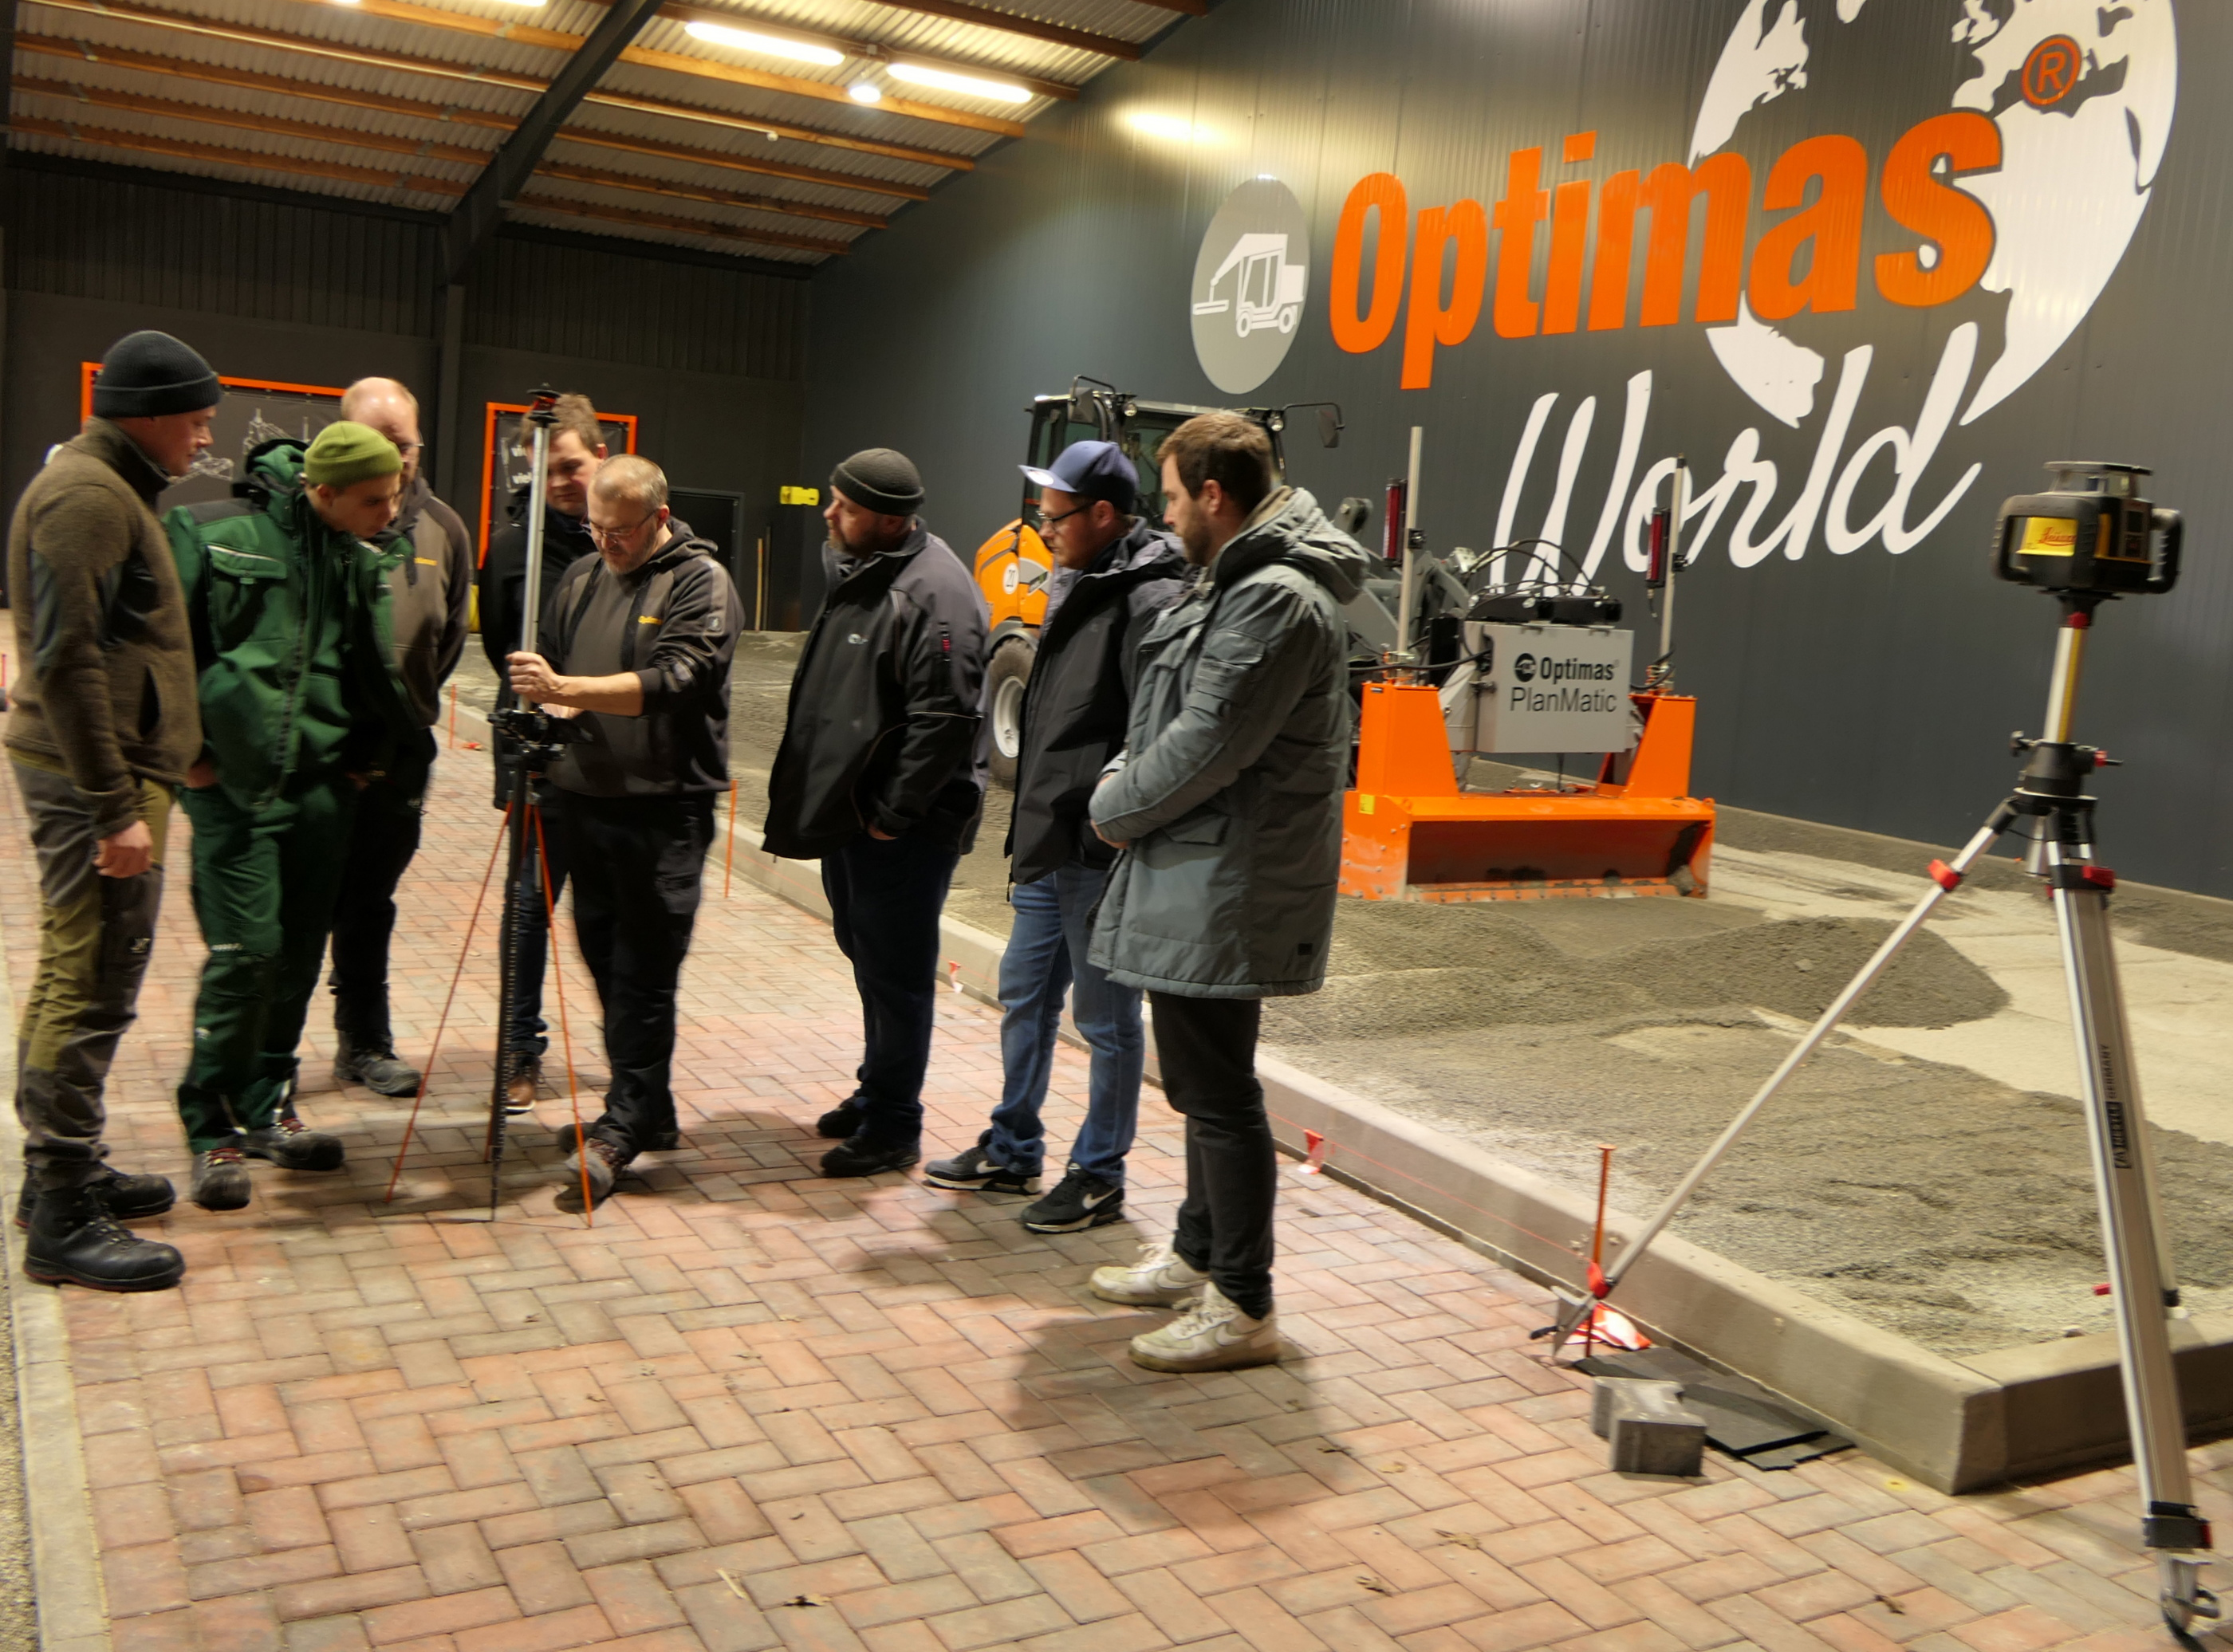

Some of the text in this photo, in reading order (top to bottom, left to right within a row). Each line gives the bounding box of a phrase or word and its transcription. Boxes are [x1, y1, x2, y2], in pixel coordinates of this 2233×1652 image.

[1330, 111, 2003, 389] Optimas
[1488, 321, 1983, 595] World
[1510, 686, 1618, 713] PlanMatic
[1540, 656, 1615, 685] Optimas
